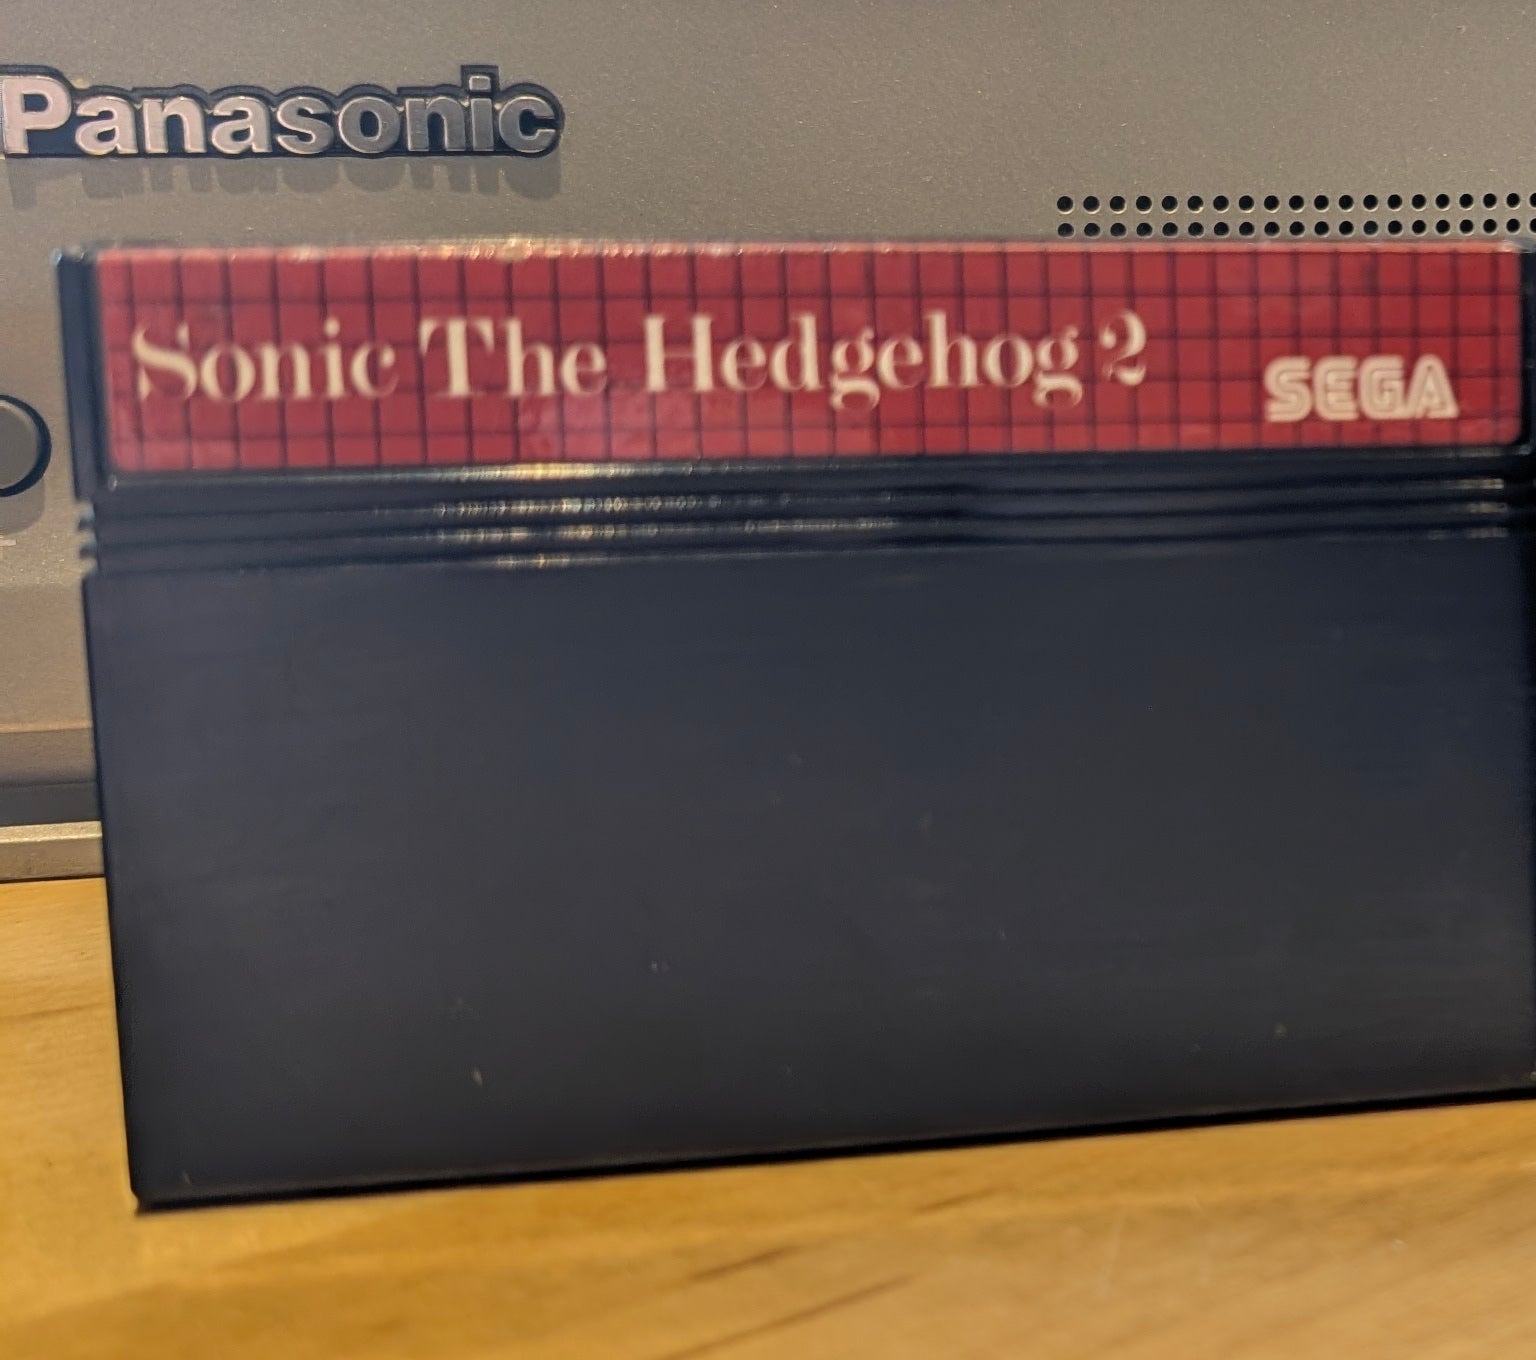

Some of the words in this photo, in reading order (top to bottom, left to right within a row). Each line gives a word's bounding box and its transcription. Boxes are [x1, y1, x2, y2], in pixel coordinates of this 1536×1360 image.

[1, 68, 562, 156] Panasonic
[132, 316, 398, 404] Sonic
[418, 314, 608, 400] The
[643, 308, 1082, 409] Hedgehog
[1101, 308, 1147, 387] 2
[1263, 353, 1460, 423] SEGA
